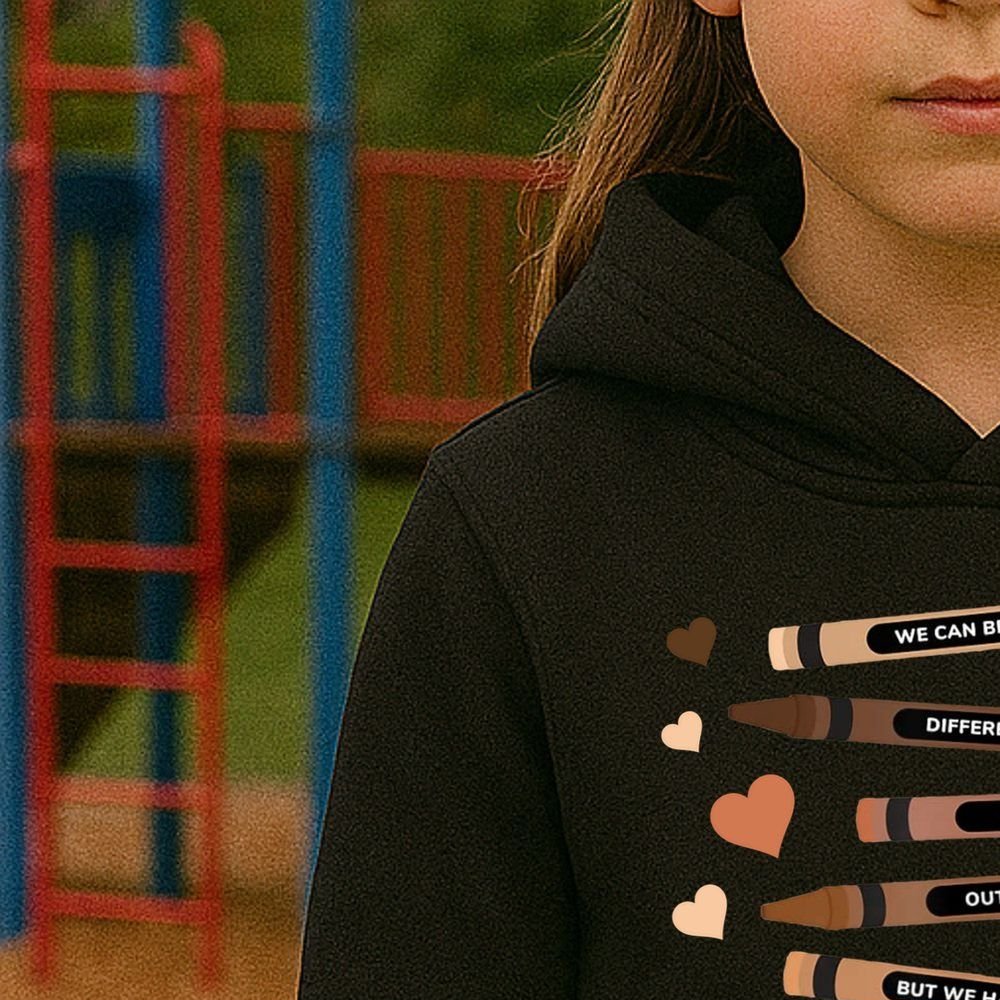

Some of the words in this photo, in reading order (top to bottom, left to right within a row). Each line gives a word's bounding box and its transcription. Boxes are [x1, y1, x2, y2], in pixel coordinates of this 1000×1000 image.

[894, 626, 928, 645] WE
[934, 622, 976, 640] CAN
[896, 980, 938, 999] BUT
